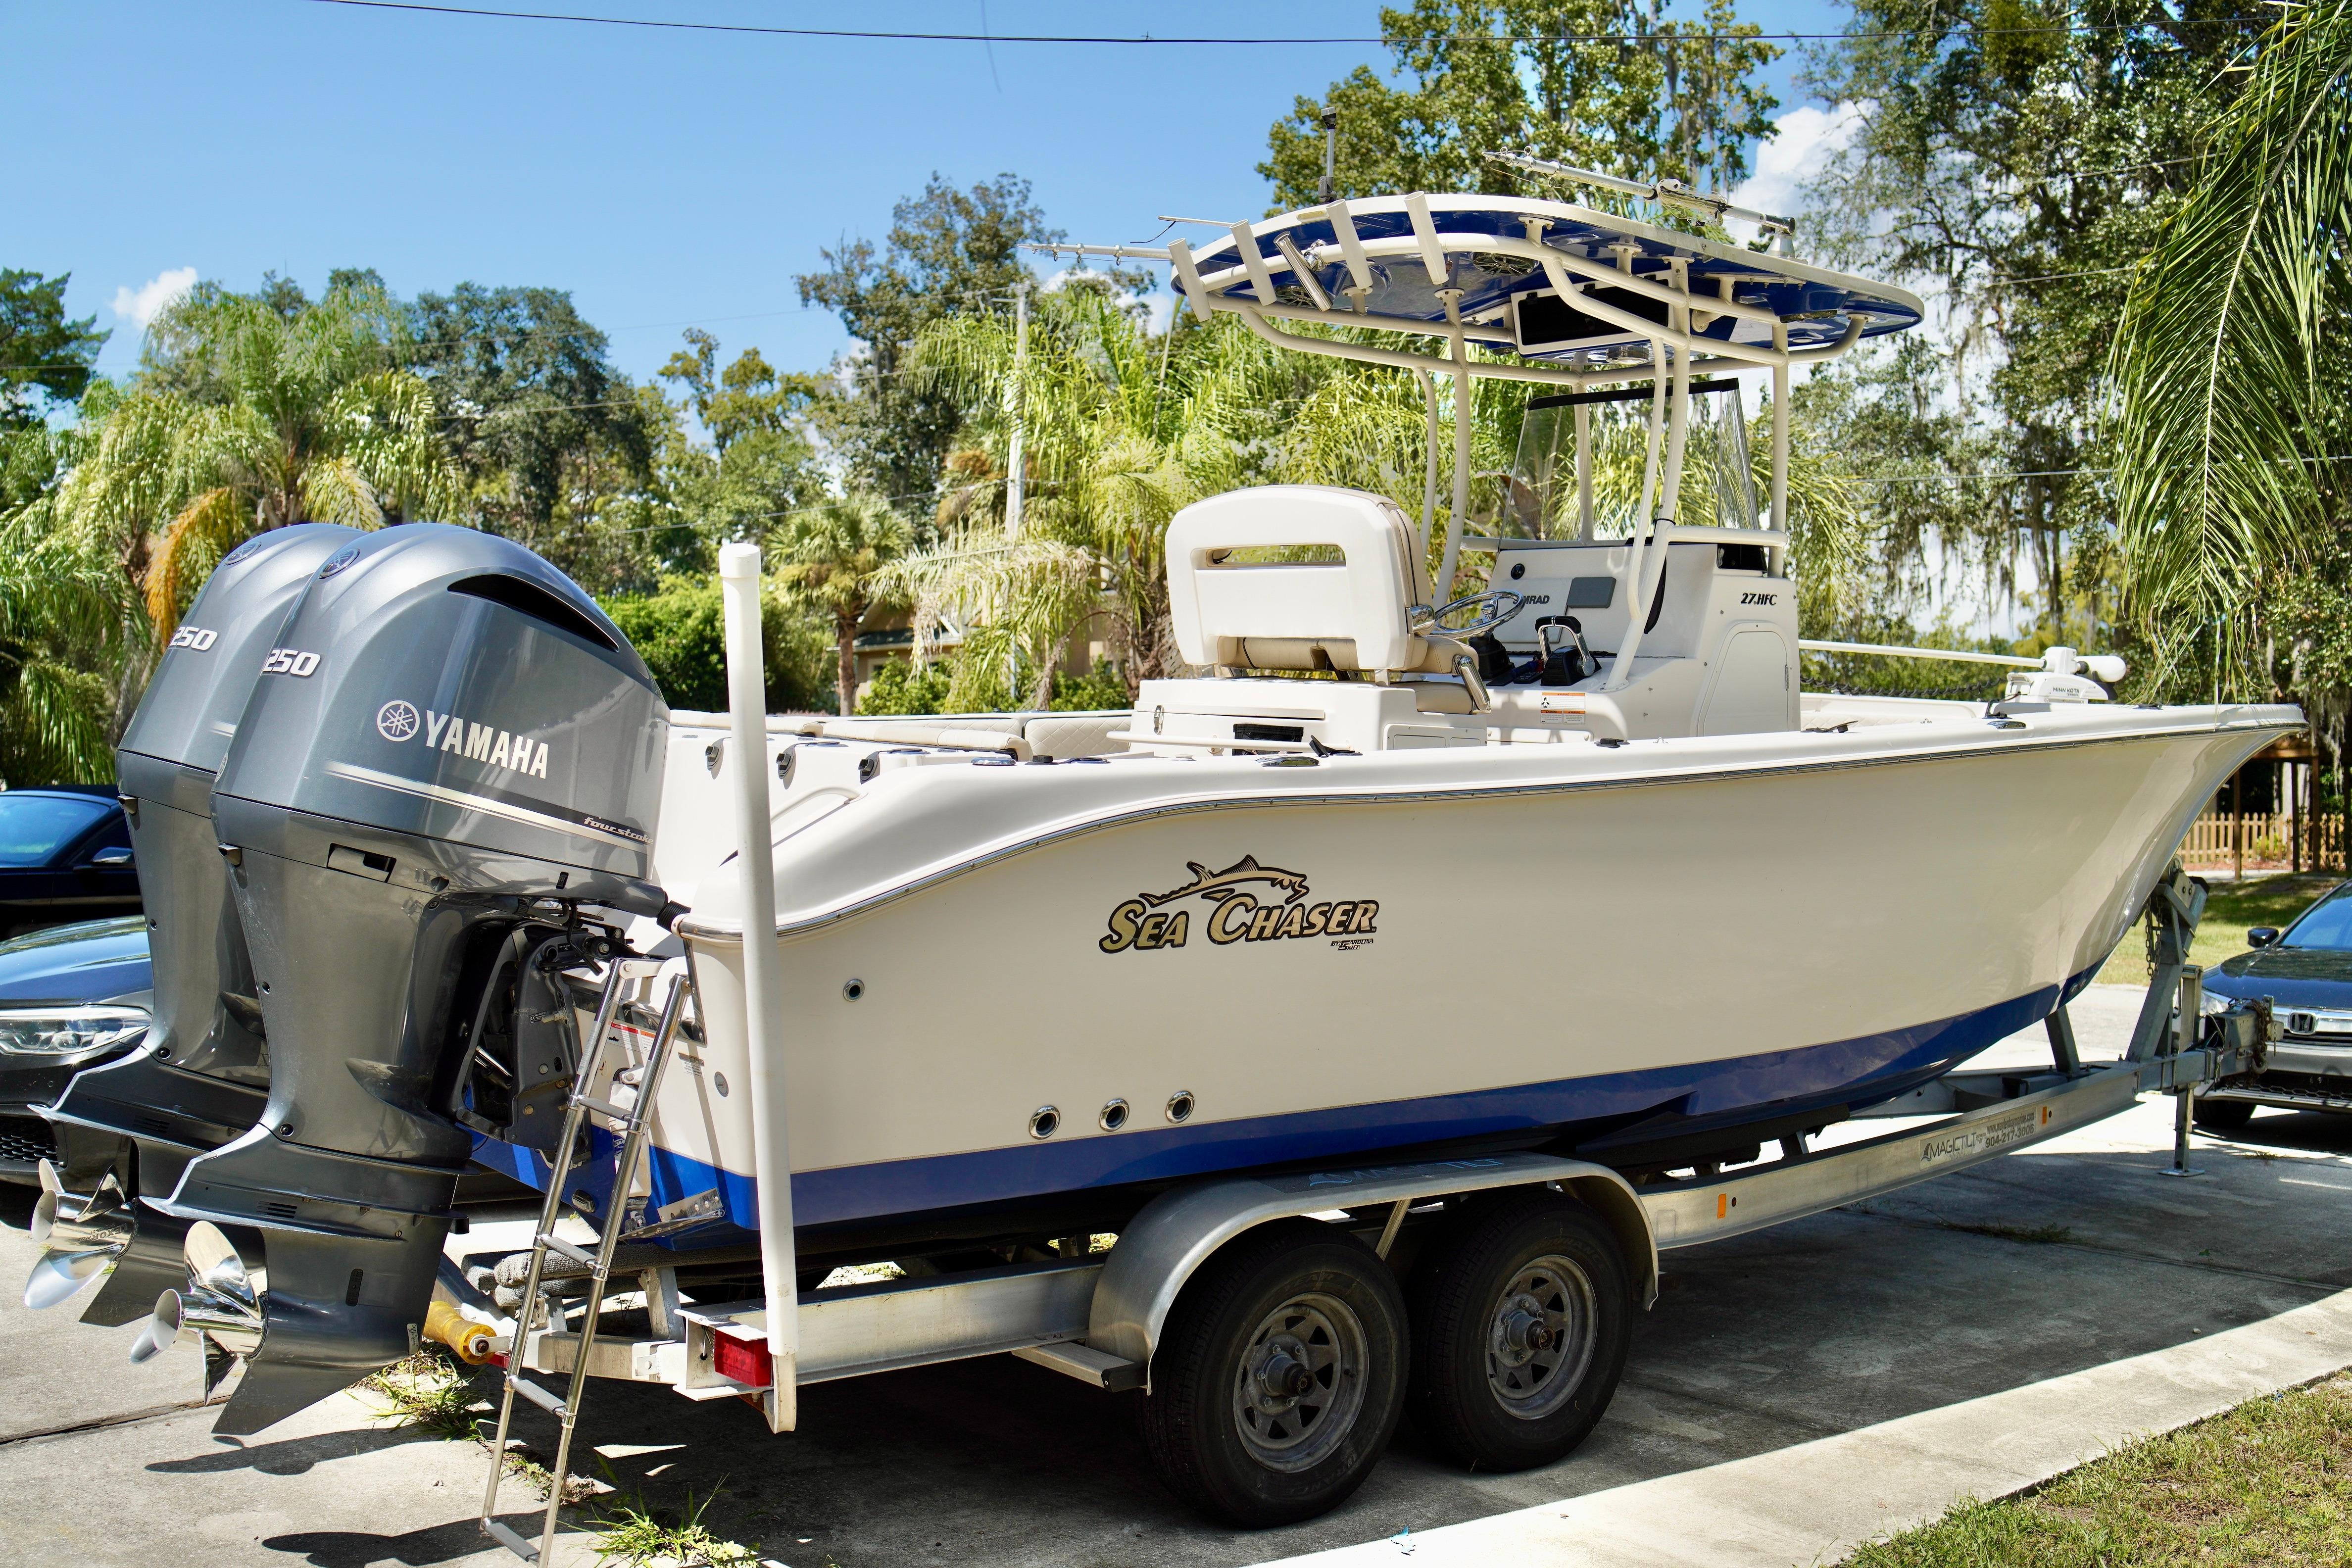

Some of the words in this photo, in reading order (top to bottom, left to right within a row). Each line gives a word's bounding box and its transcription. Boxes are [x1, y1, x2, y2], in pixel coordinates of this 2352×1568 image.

[169, 627, 218, 651] 250
[262, 649, 321, 677] 250
[426, 710, 548, 780] YAMAHA
[1099, 899, 1189, 954] SEA
[1207, 893, 1379, 945] CHASER
